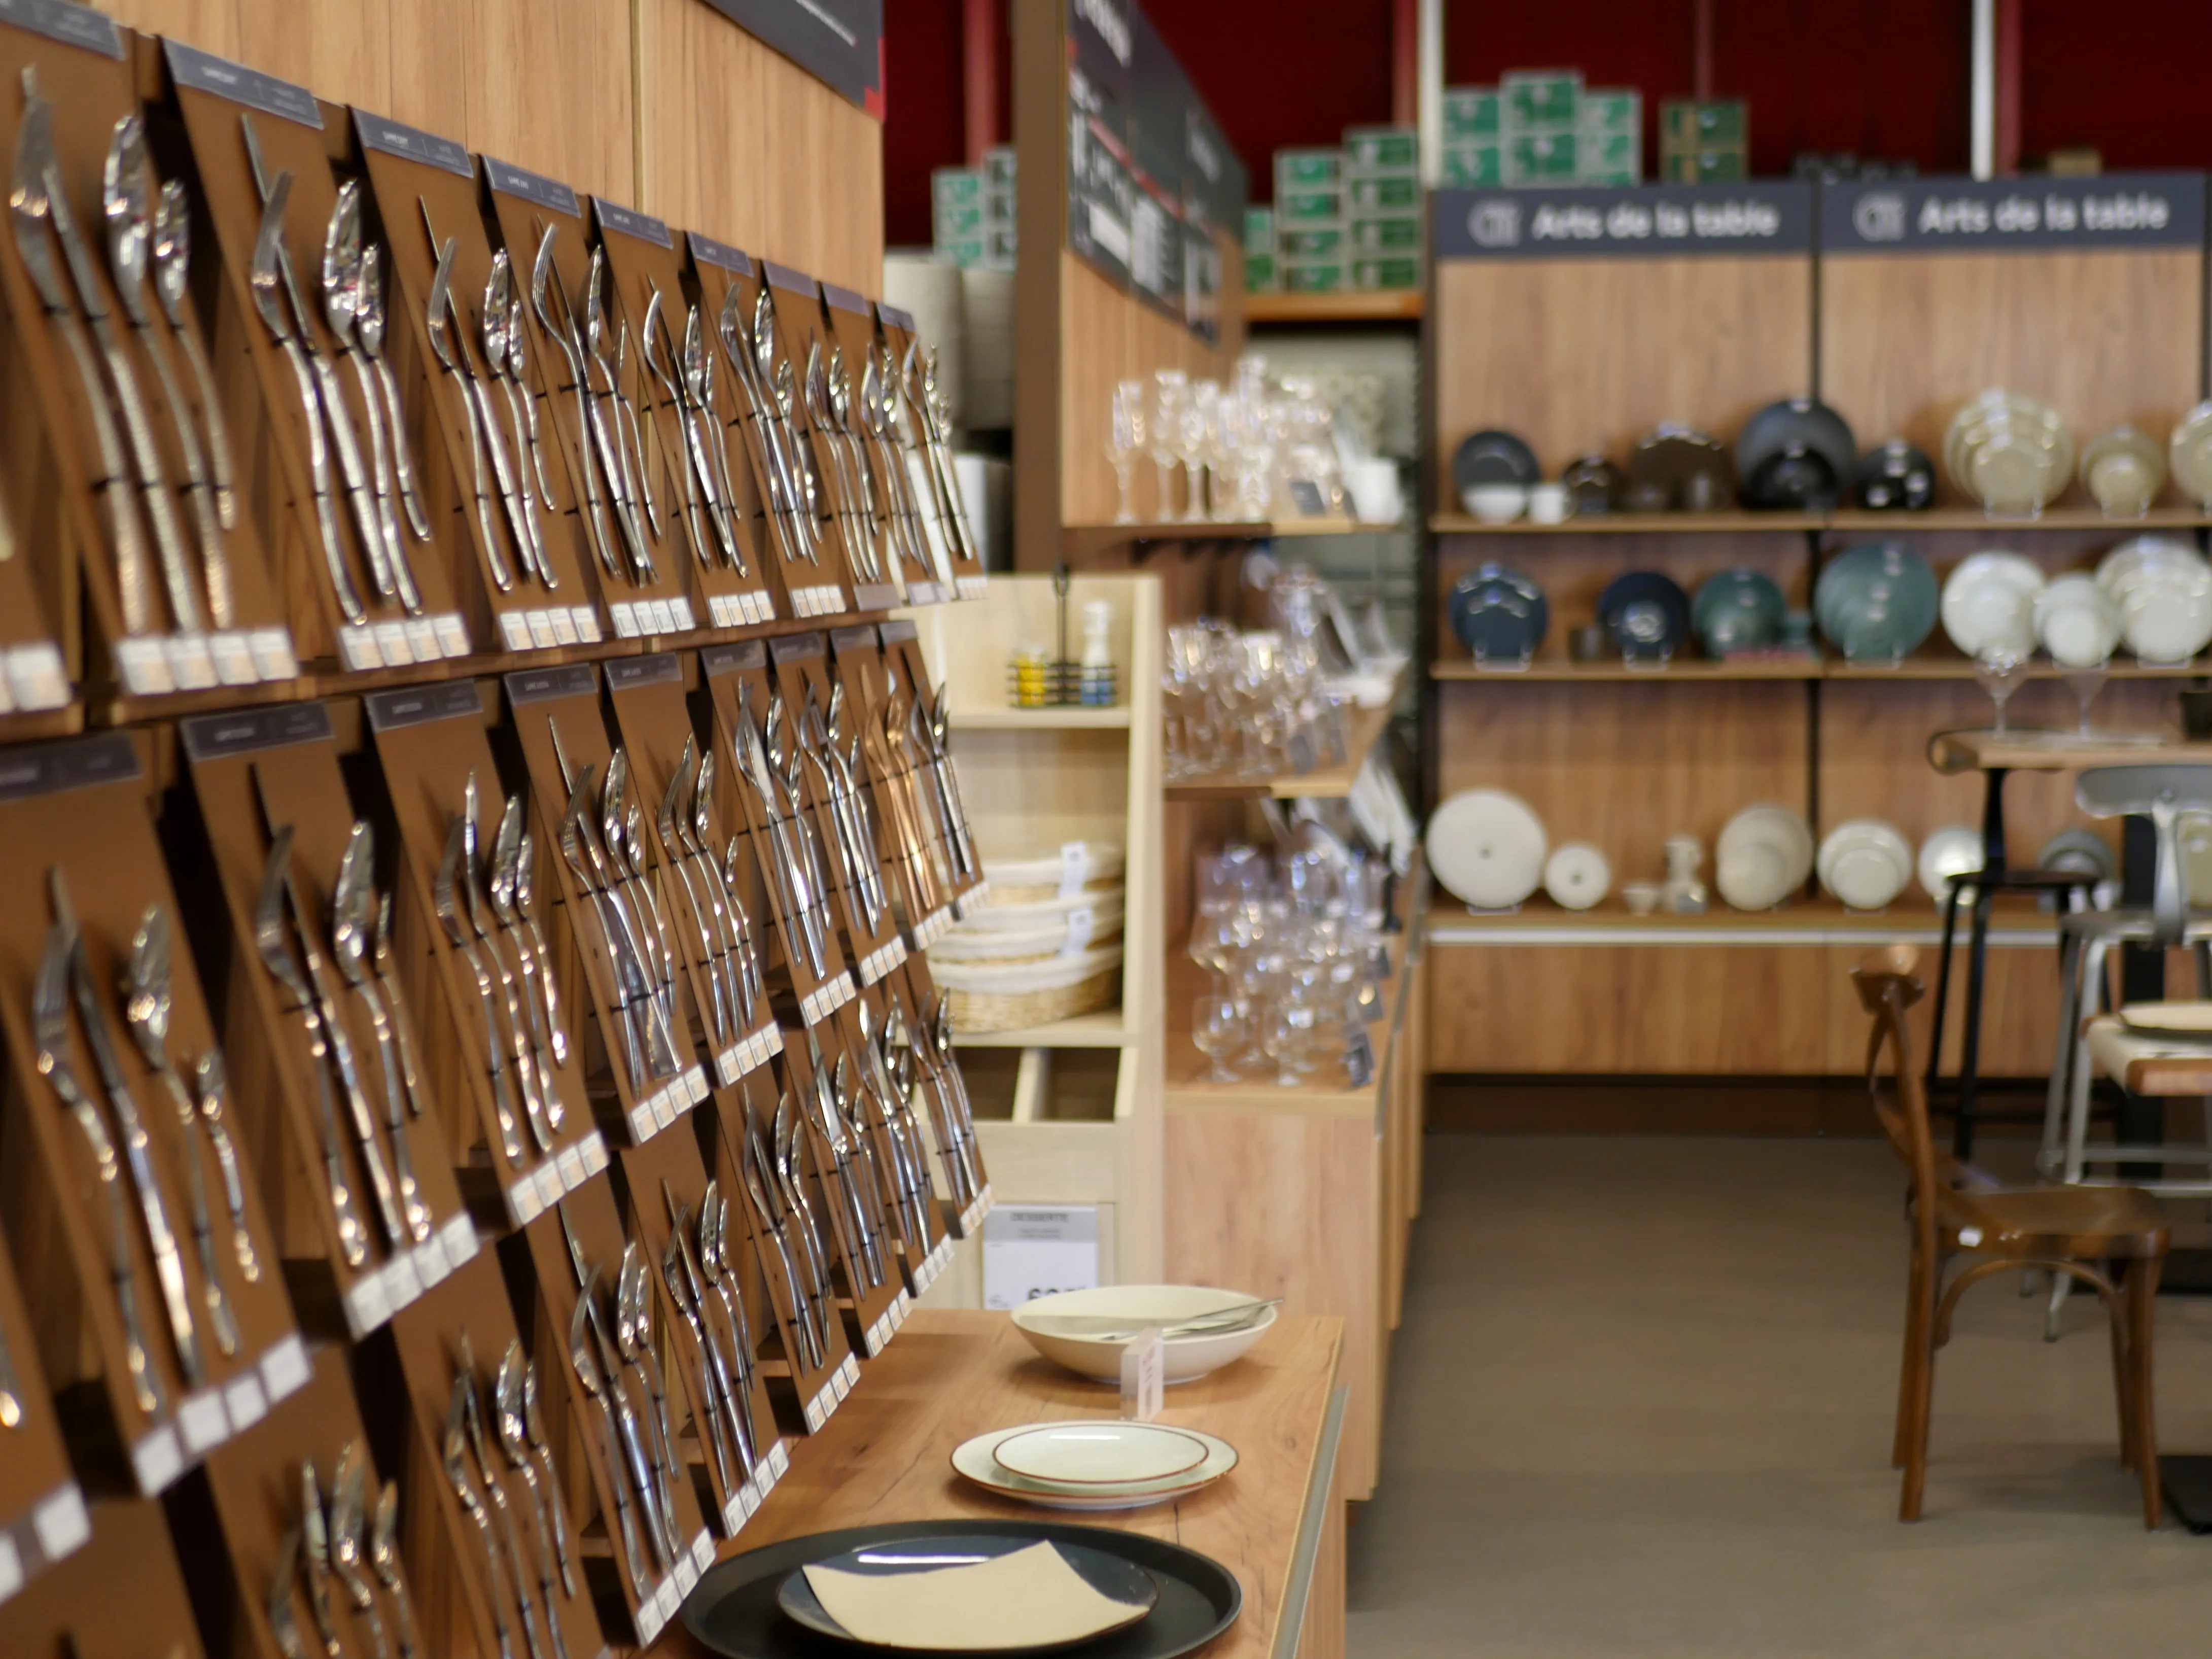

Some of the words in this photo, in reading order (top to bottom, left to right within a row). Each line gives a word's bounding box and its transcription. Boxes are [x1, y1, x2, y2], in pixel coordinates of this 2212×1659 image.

[1532, 203, 1604, 239] Arts
[1606, 201, 1652, 239] de
[1656, 200, 1690, 238] la
[1693, 199, 1780, 238] table
[1918, 195, 1990, 233] Arts
[1994, 192, 2040, 232] de
[2044, 193, 2078, 231] la
[2083, 191, 2169, 230] table
